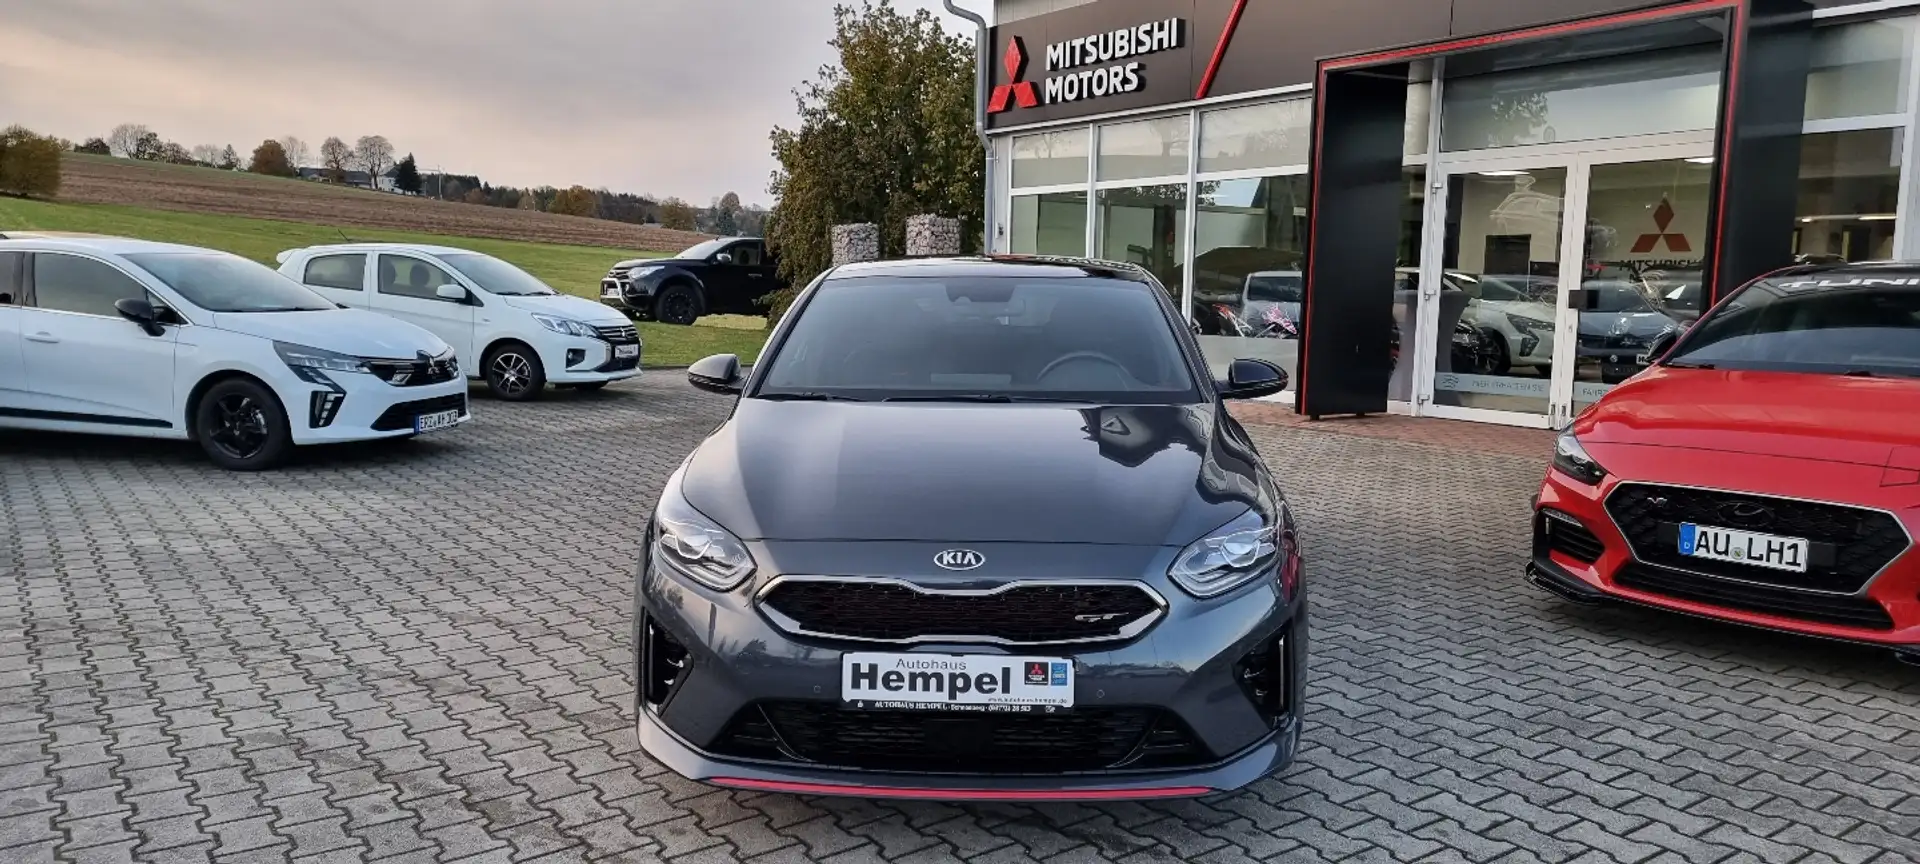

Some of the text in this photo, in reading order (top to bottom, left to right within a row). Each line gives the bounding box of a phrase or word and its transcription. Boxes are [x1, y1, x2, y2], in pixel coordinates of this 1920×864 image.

[1045, 17, 1178, 71] MITSUBISHI
[1045, 62, 1139, 104] MOTORS
[1695, 530, 1731, 557] AU
[942, 551, 977, 565] KIA
[1074, 611, 1130, 623] GT
[895, 658, 967, 671] Autohaus
[851, 662, 1011, 700] Hempel
[874, 701, 914, 709] AUTOHAUS
[916, 702, 948, 710] HEMPEL
